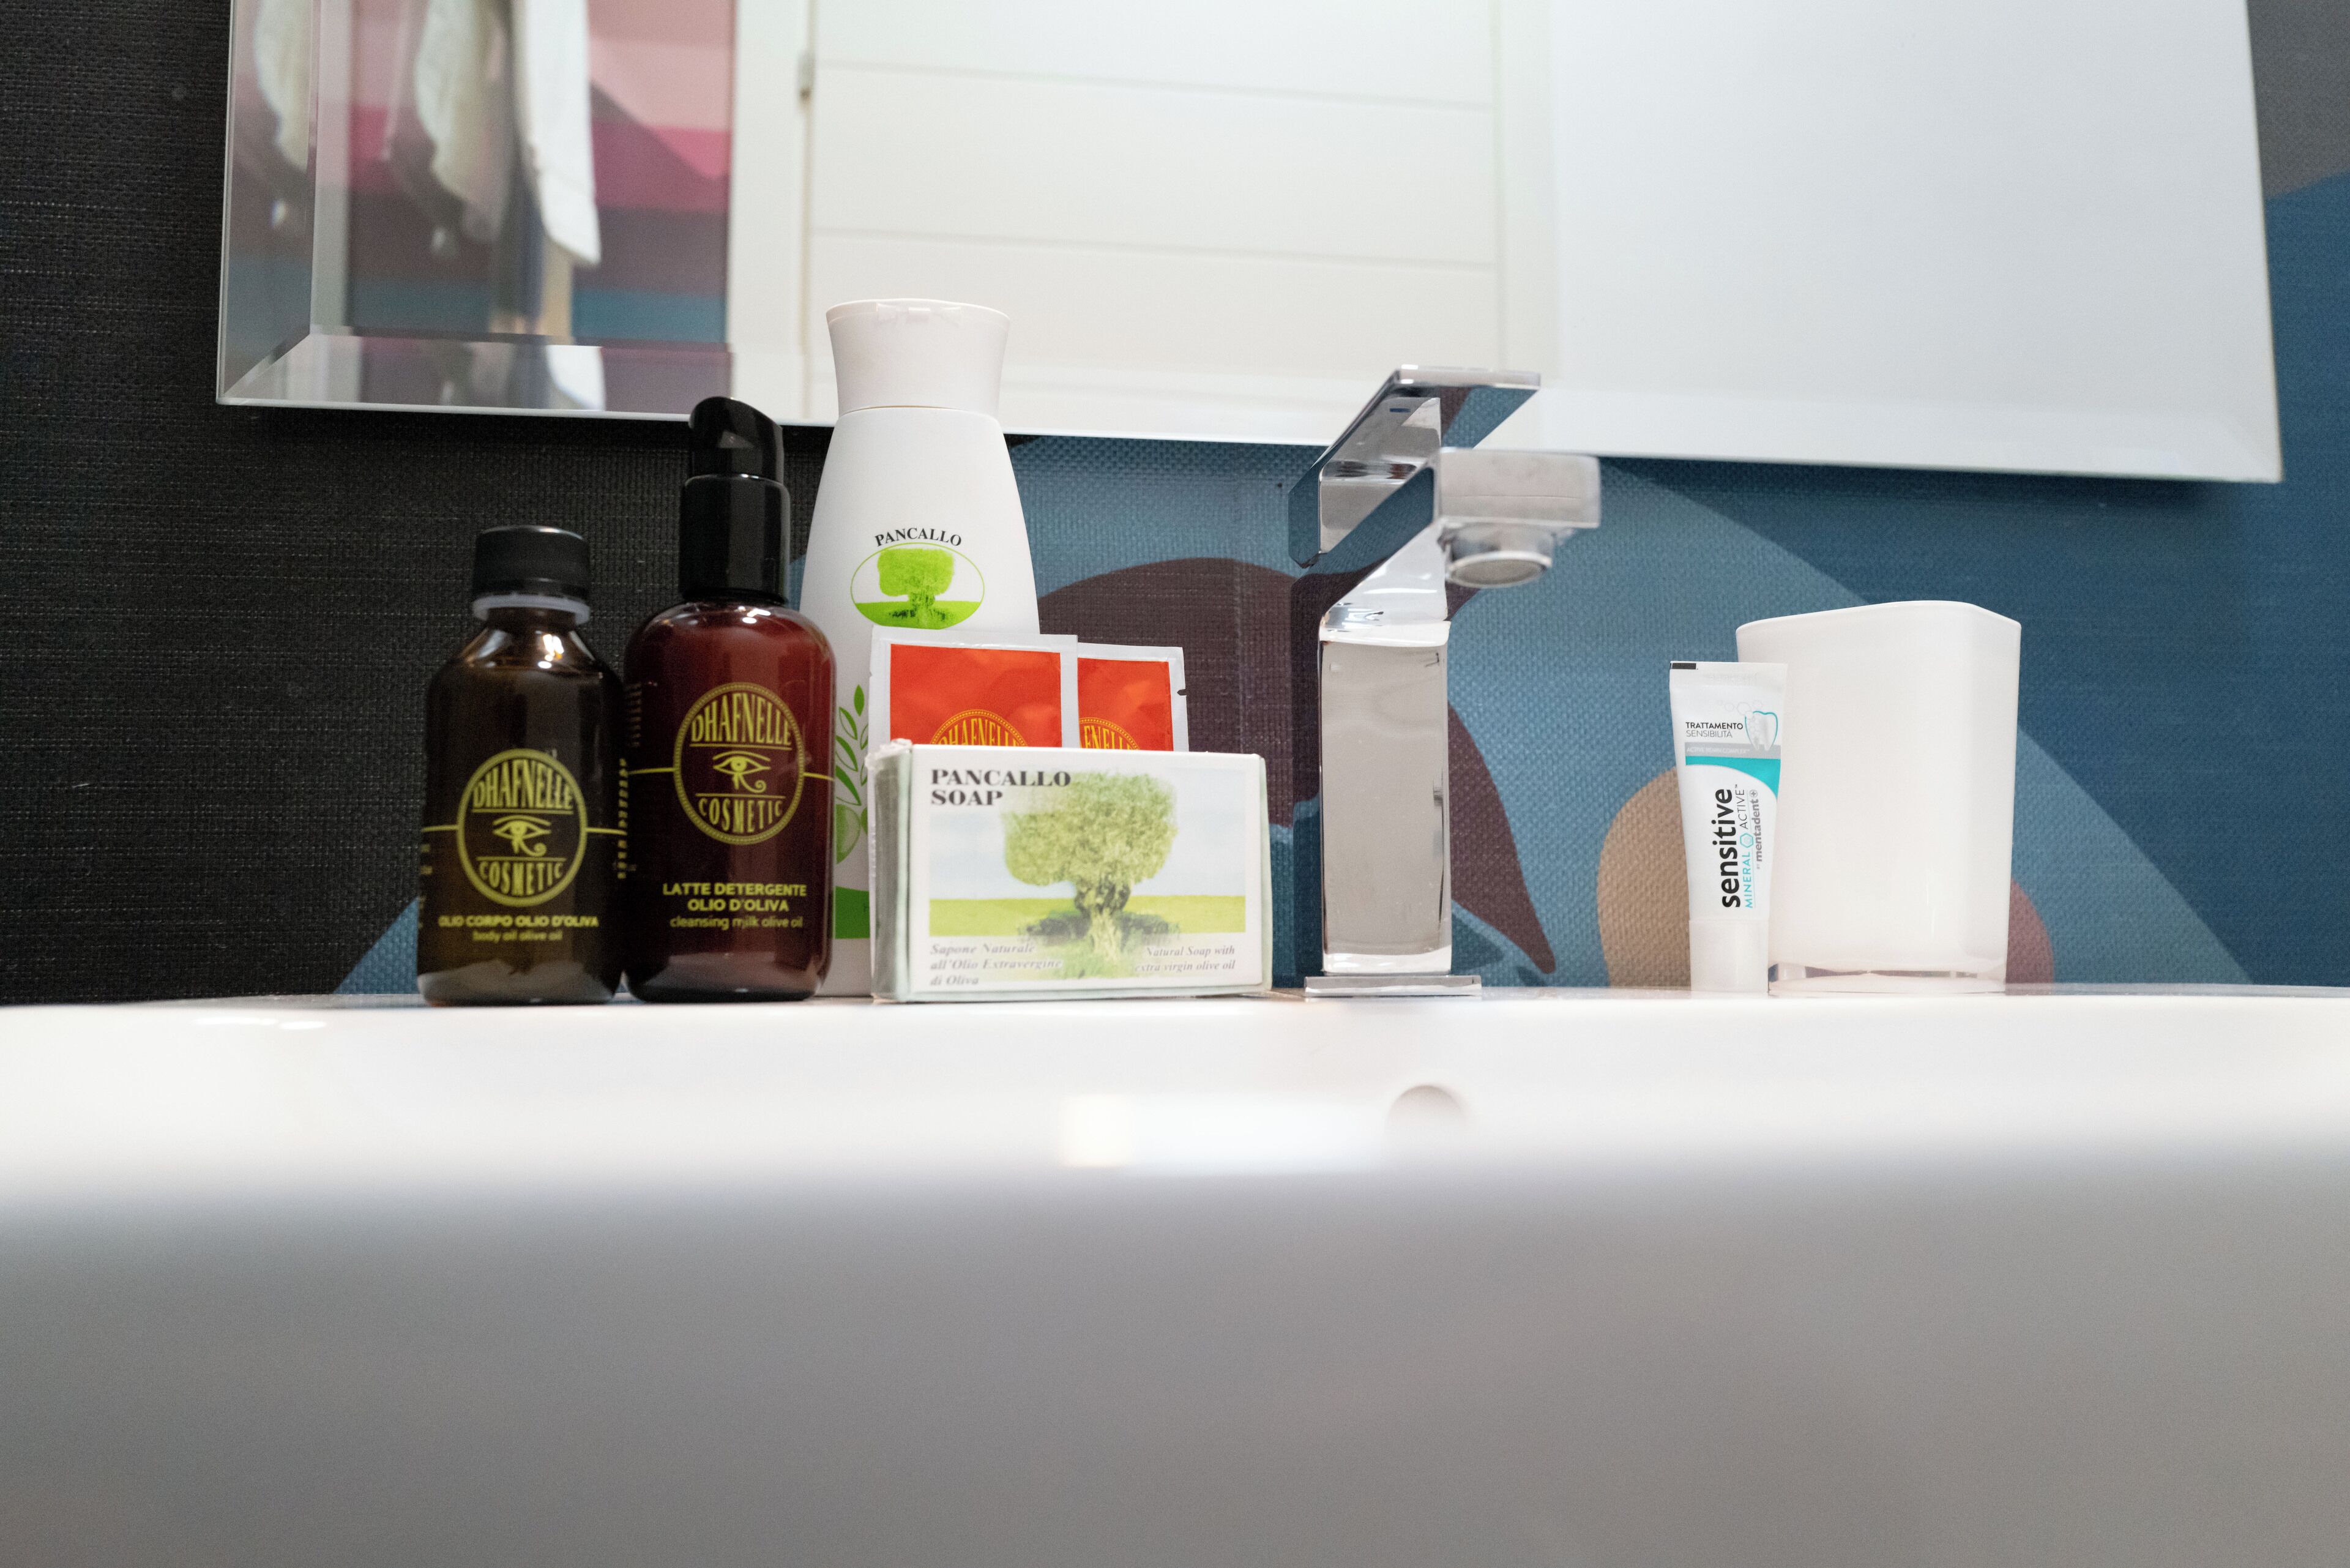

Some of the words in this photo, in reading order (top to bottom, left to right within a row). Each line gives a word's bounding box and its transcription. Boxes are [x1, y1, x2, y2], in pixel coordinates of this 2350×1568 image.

[875, 528, 961, 547] PANCALLO
[691, 693, 792, 745] DHAFNELLE
[1685, 722, 1744, 730] TRATTAMENTO
[1685, 729, 1733, 738] SENSIBILITÀ
[472, 759, 573, 810] DHAFNELLE
[931, 769, 1071, 787] PANCALLO
[931, 790, 1003, 805] SOAP
[698, 798, 783, 833] COSMETIC
[1711, 789, 1741, 908] sensitive
[479, 861, 563, 896] COSMETIC
[1742, 851, 1753, 908] MINERAL
[663, 883, 711, 895] LATTE
[714, 883, 807, 897] DETERGENTE
[687, 898, 726, 911] OLIO
[729, 899, 789, 911] D'OLIVA
[515, 915, 550, 927] OLIO
[670, 916, 729, 930] cleansing
[733, 915, 759, 928] milk
[761, 916, 789, 928] olive
[791, 916, 804, 928] oil
[930, 944, 977, 957] Sapone
[980, 943, 1035, 954] Naturale
[1147, 947, 1184, 957] Natural
[1186, 946, 1211, 958] Soap
[1214, 946, 1235, 955] with
[982, 958, 1061, 969] Extravergine
[1135, 963, 1161, 971] extra
[1164, 961, 1193, 972] virgin
[1196, 961, 1220, 970] olive
[1222, 960, 1236, 969] oil
[930, 974, 941, 985] di
[946, 974, 979, 985] Oliva
